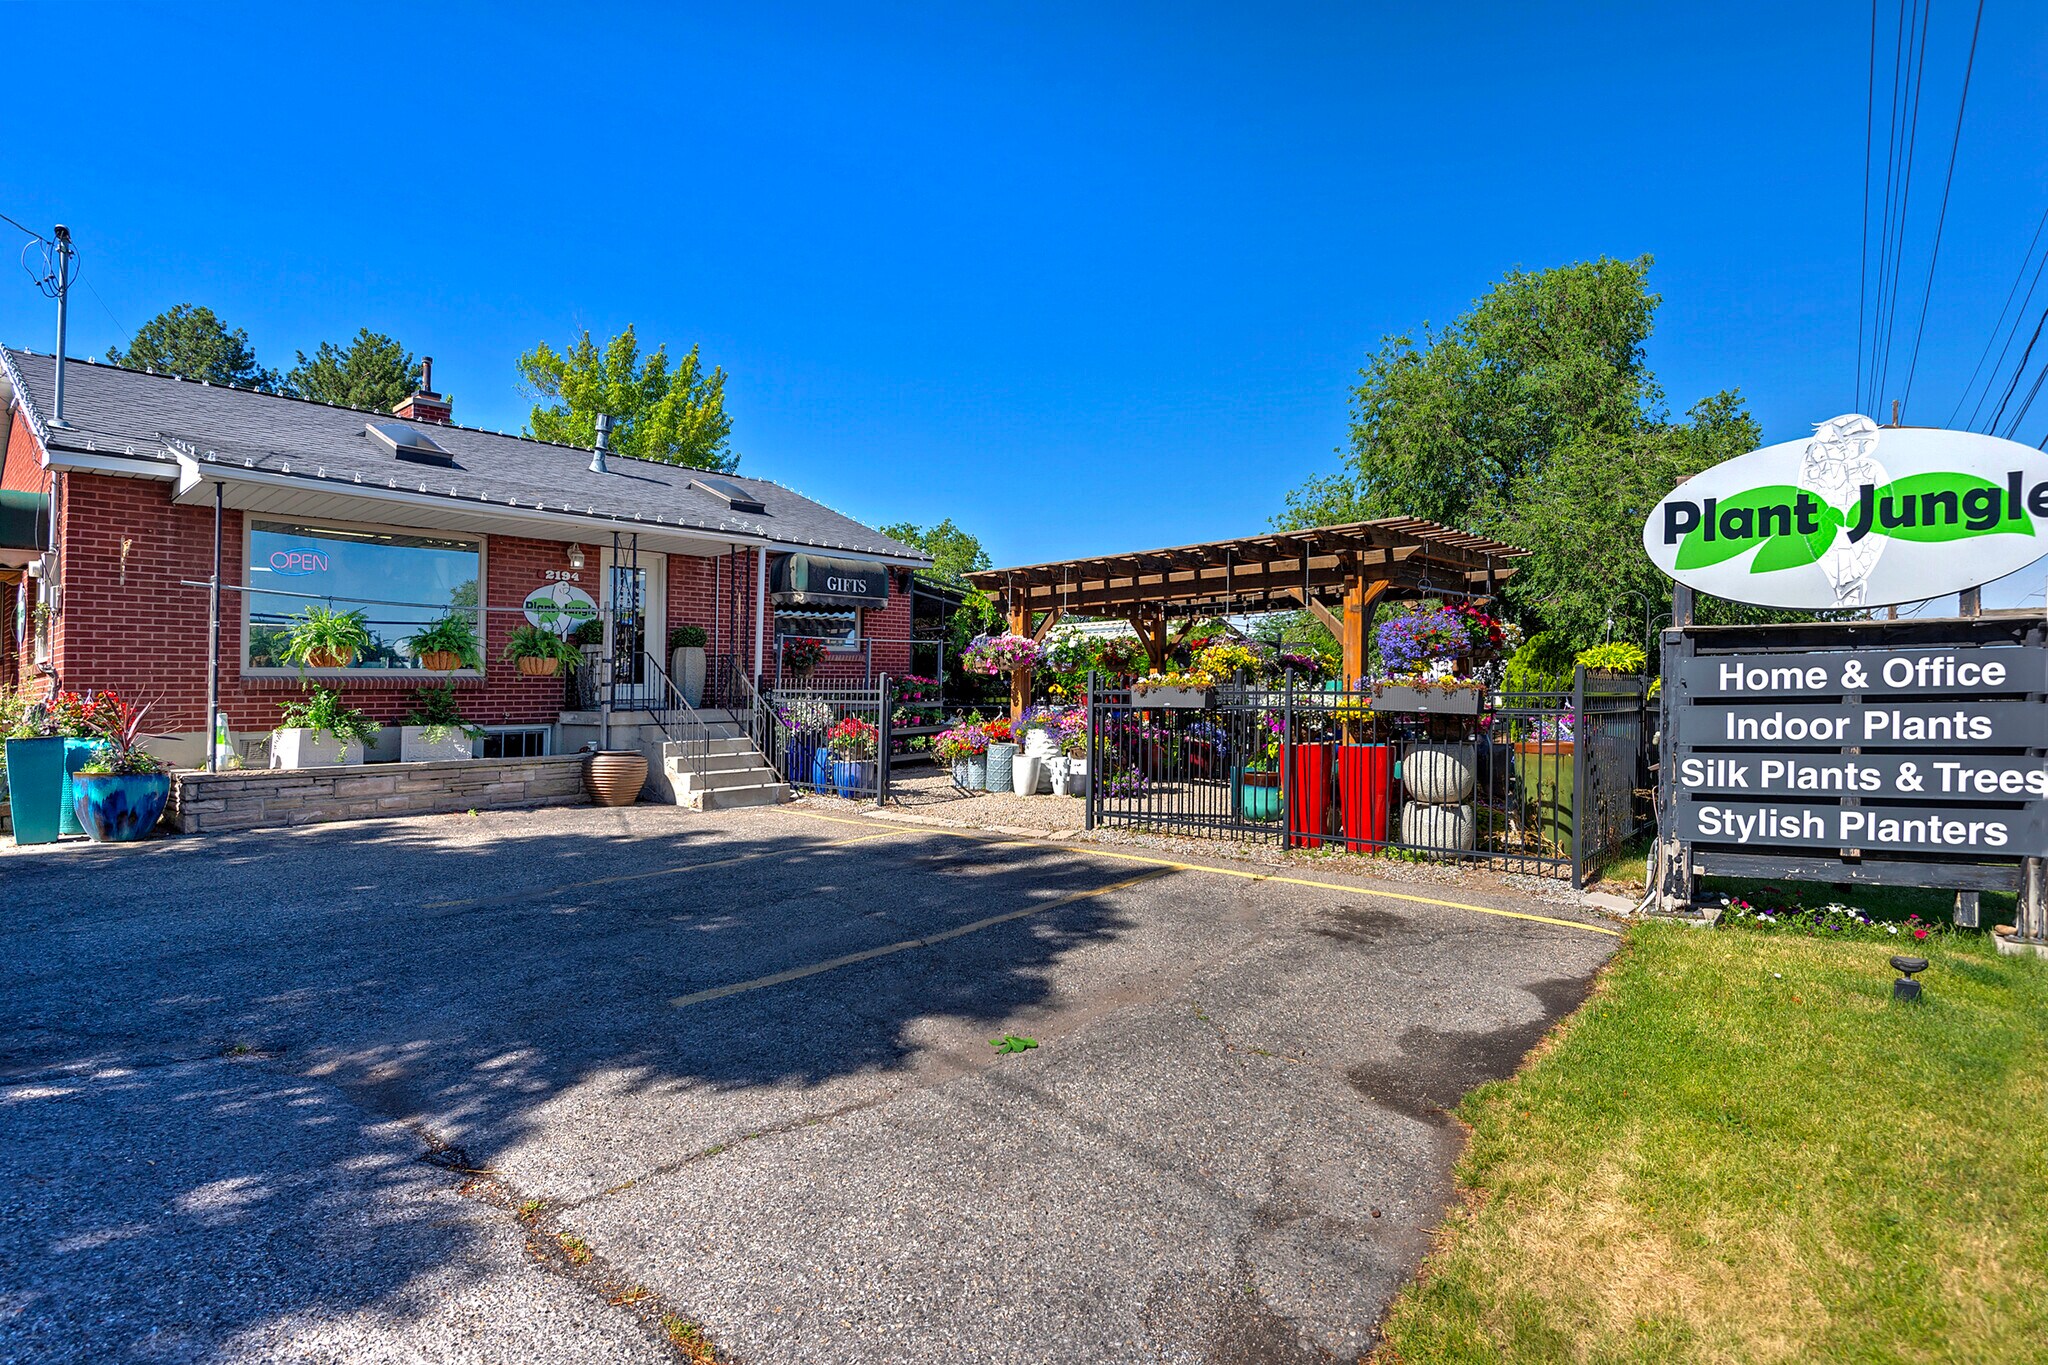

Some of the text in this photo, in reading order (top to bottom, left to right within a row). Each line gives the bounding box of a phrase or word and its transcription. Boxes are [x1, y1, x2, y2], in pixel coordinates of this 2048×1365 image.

[1664, 470, 2048, 545] Plant Jungle
[270, 551, 329, 571] OPEN
[545, 570, 580, 582] 2194
[826, 576, 867, 593] GIFTS
[1719, 656, 2006, 691] Home & Office
[1726, 710, 1993, 740] Indoor Plants
[1680, 758, 2047, 795] Silk Plants & Trees
[1697, 806, 2008, 847] Stylish Planters
